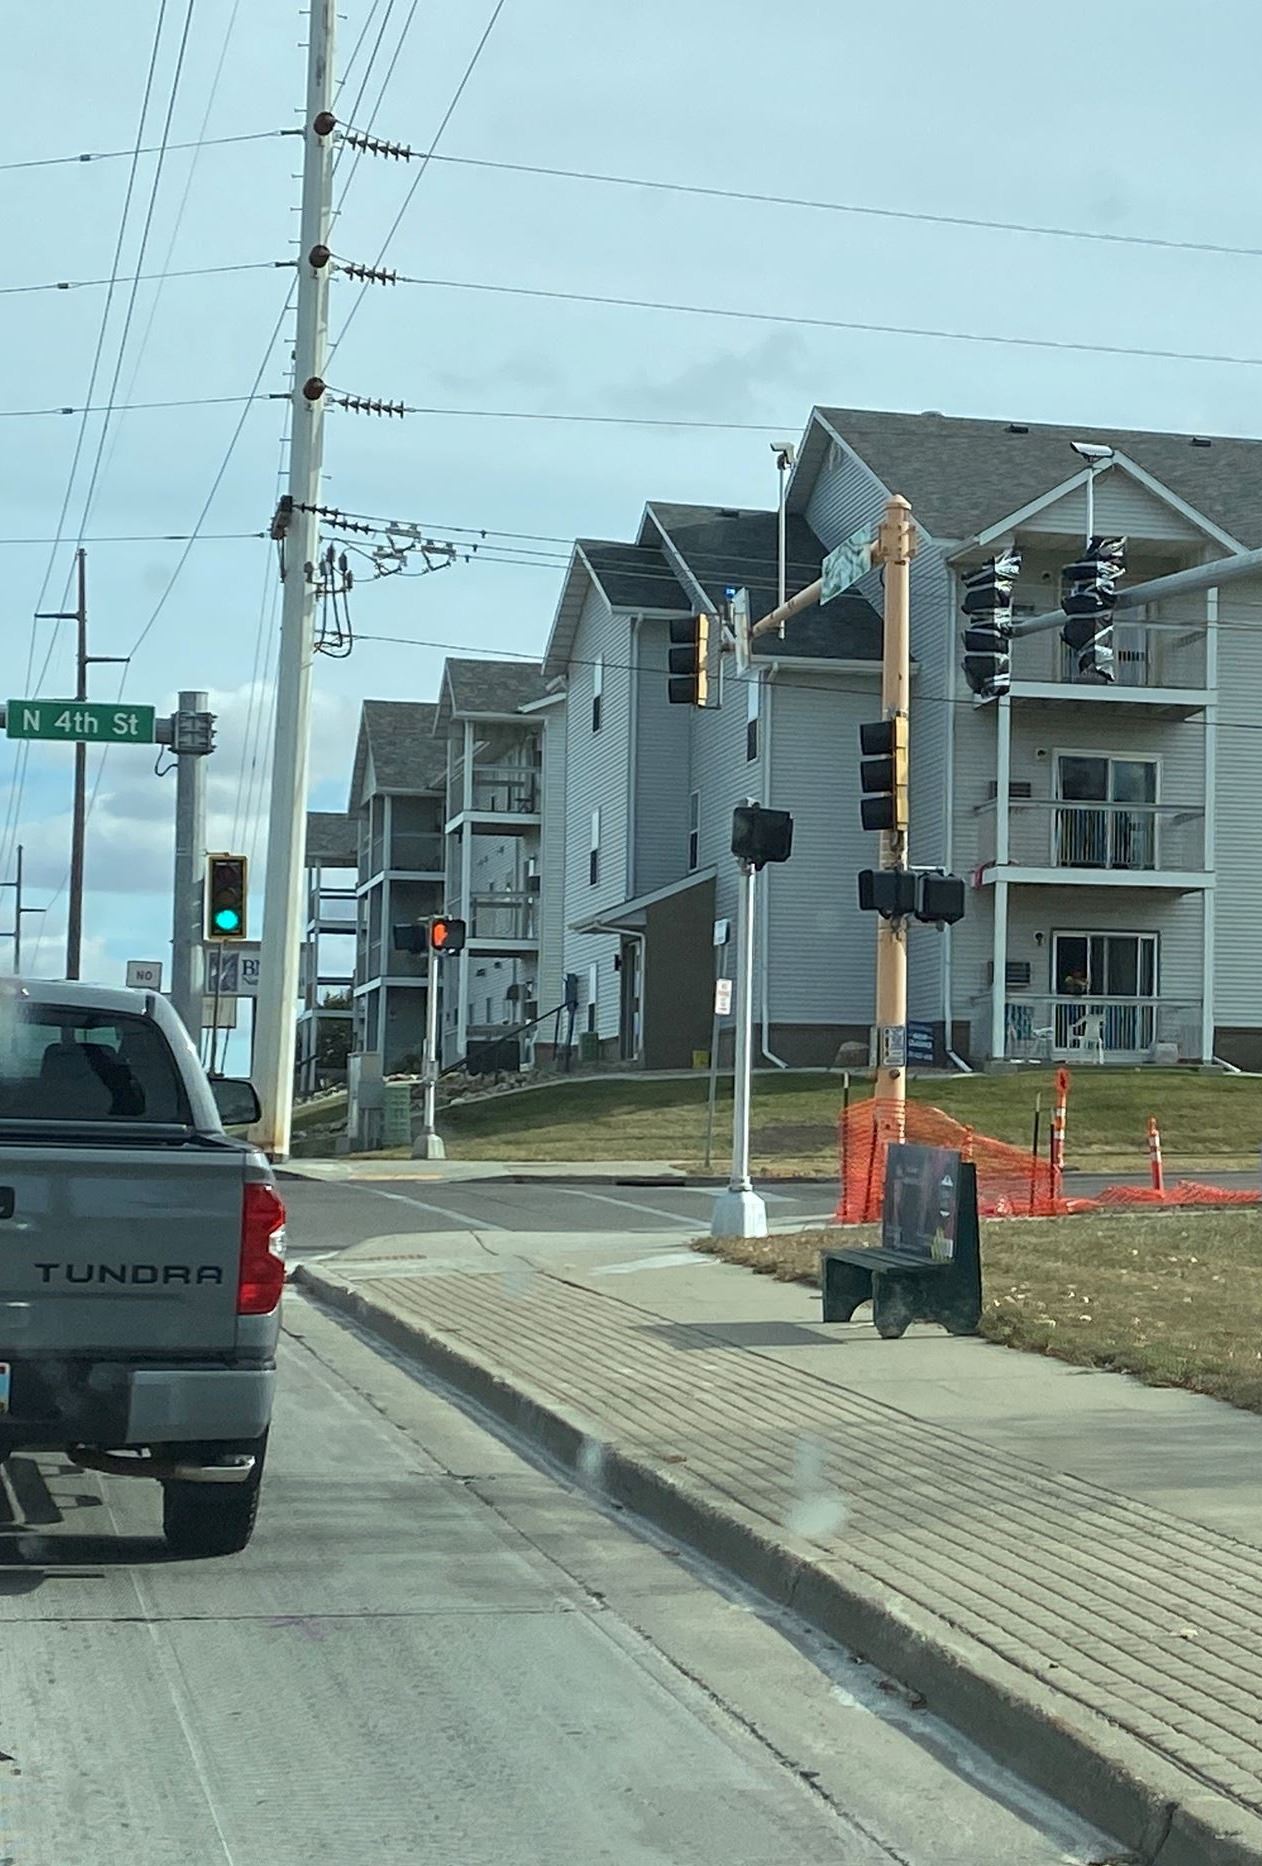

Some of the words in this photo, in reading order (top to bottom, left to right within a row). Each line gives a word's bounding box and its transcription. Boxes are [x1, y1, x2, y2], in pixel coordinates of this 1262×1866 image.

[23, 709, 40, 731] N
[54, 710, 99, 734] 4th
[112, 712, 139, 735] St
[136, 970, 153, 981] NO
[33, 1262, 223, 1285] TUNDRA
